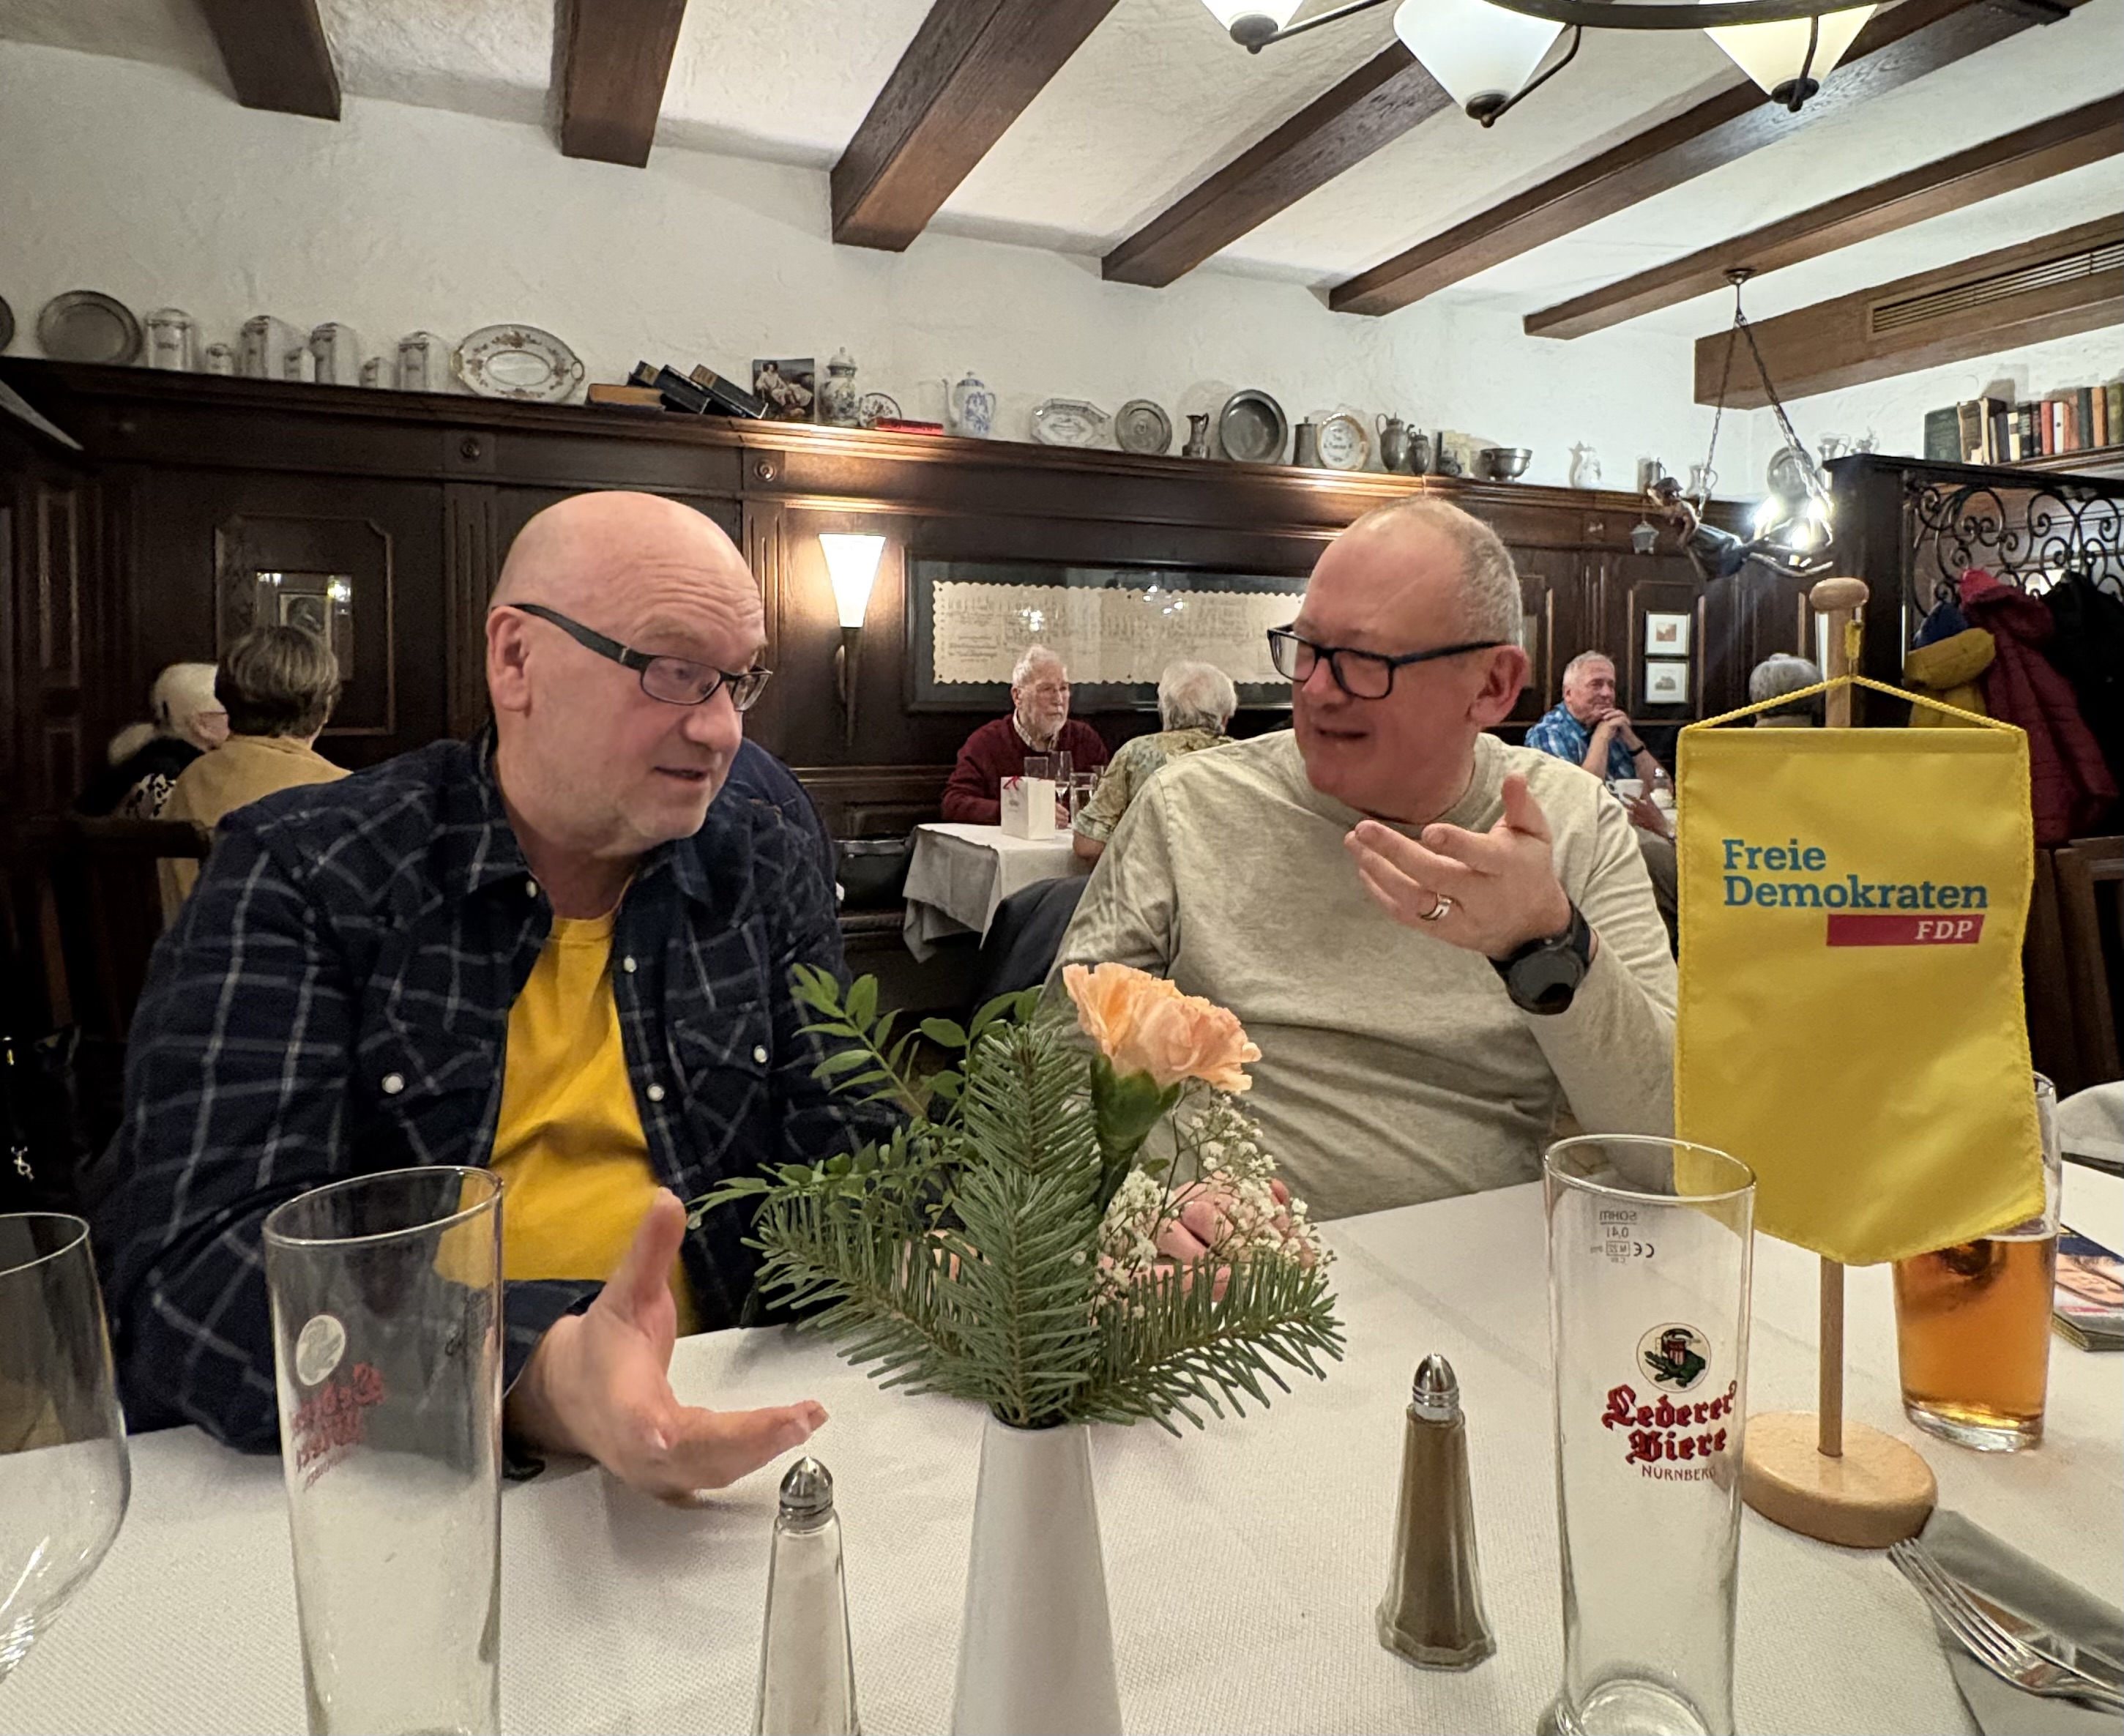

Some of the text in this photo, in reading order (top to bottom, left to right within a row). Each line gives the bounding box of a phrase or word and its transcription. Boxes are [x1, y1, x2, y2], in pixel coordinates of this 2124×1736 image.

[1722, 838, 1826, 872] Freie
[1723, 874, 1988, 909] Demokraten
[1915, 920, 1973, 940] FDP
[1601, 1380, 1737, 1431] Lederer
[1625, 1428, 1727, 1464] Biere
